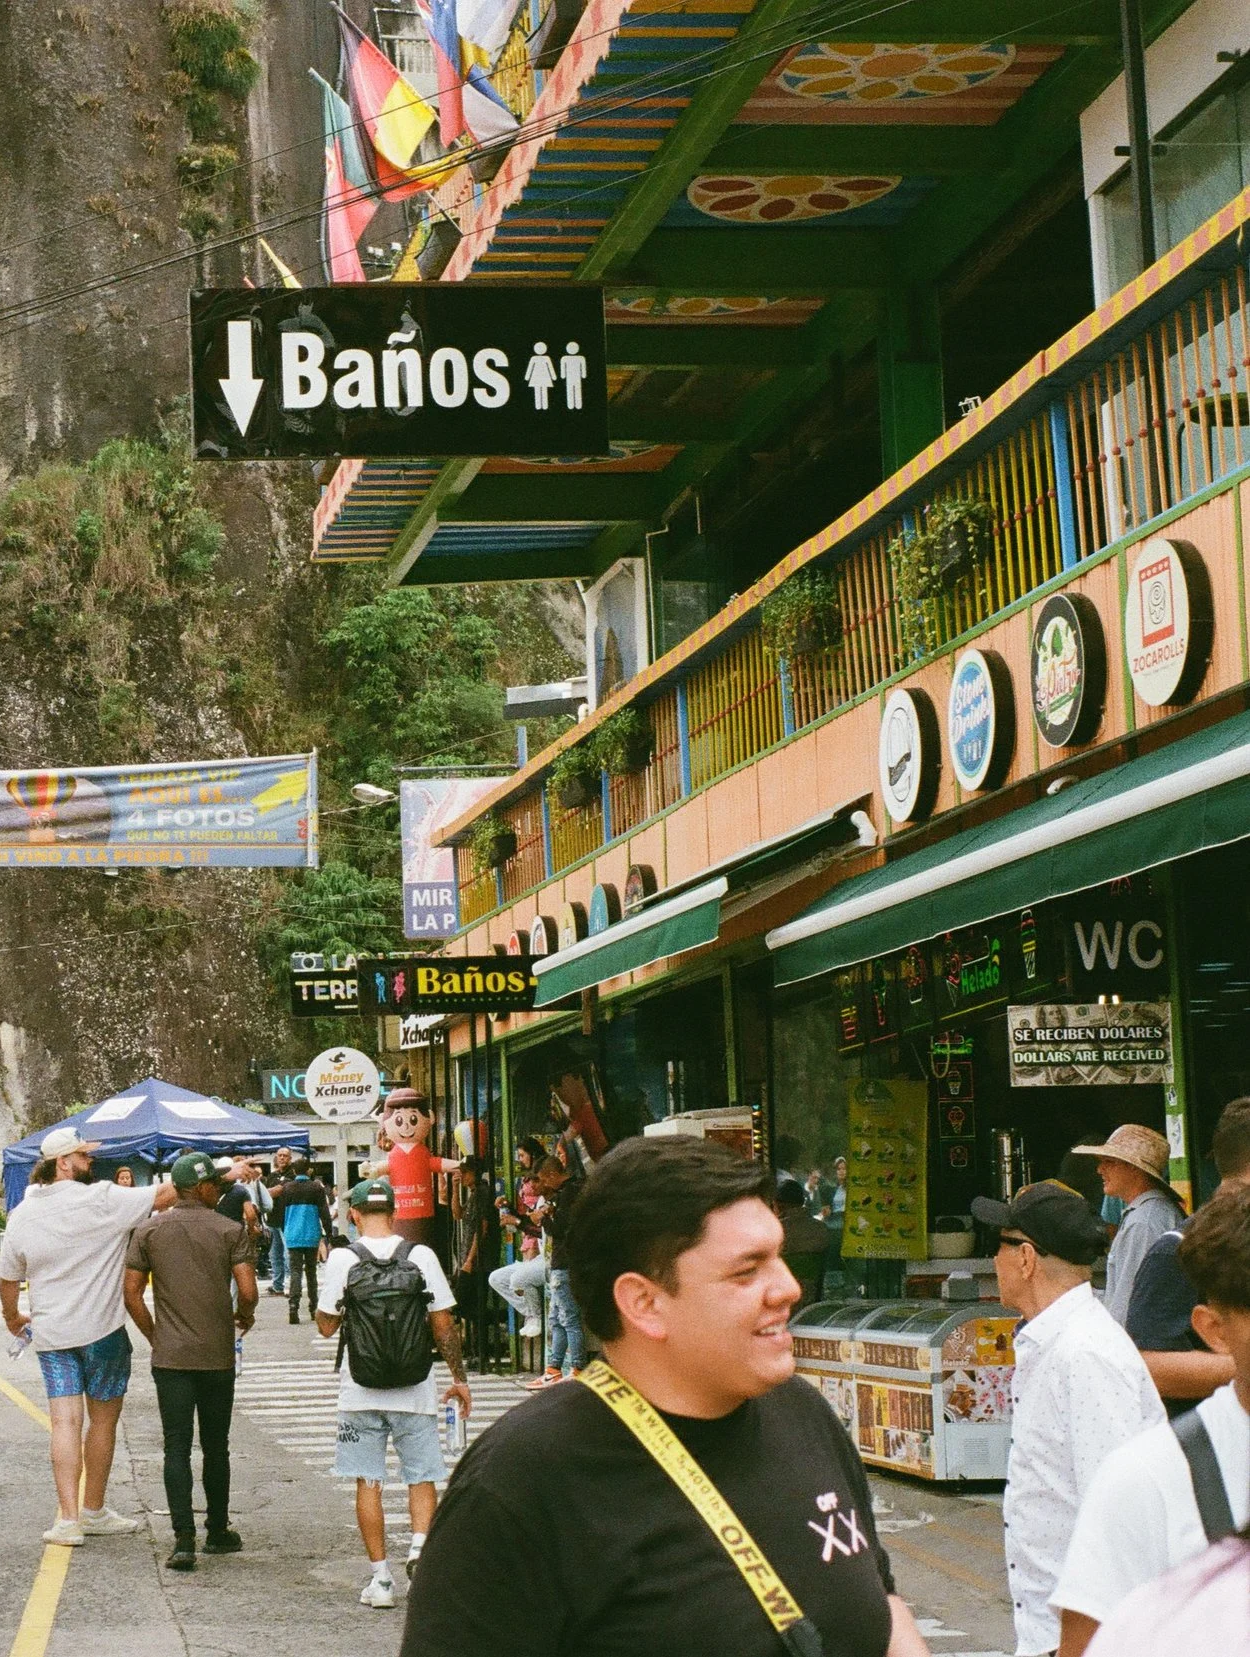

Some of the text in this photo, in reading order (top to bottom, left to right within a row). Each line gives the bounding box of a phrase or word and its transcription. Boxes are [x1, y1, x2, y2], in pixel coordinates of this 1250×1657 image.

[281, 329, 510, 409] Baños
[1133, 638, 1185, 673] ZOCAROLLS
[118, 769, 202, 784] TERRAZA
[127, 808, 255, 827] 4 FOTOS
[153, 831, 170, 842] NO
[15, 850, 62, 864] VINO
[85, 850, 109, 863] LA
[114, 850, 185, 864] PIEDRA
[413, 888, 453, 907] MIR
[413, 913, 438, 931] LA
[1074, 920, 1164, 971] WC
[417, 966, 526, 994] Baños
[1014, 1026, 1163, 1042] SE RECIBEN DOLARES
[1014, 1049, 1165, 1063] DOLLARS ARE RECEIVED
[319, 1071, 364, 1085] Money
[315, 1084, 372, 1098] Xchange
